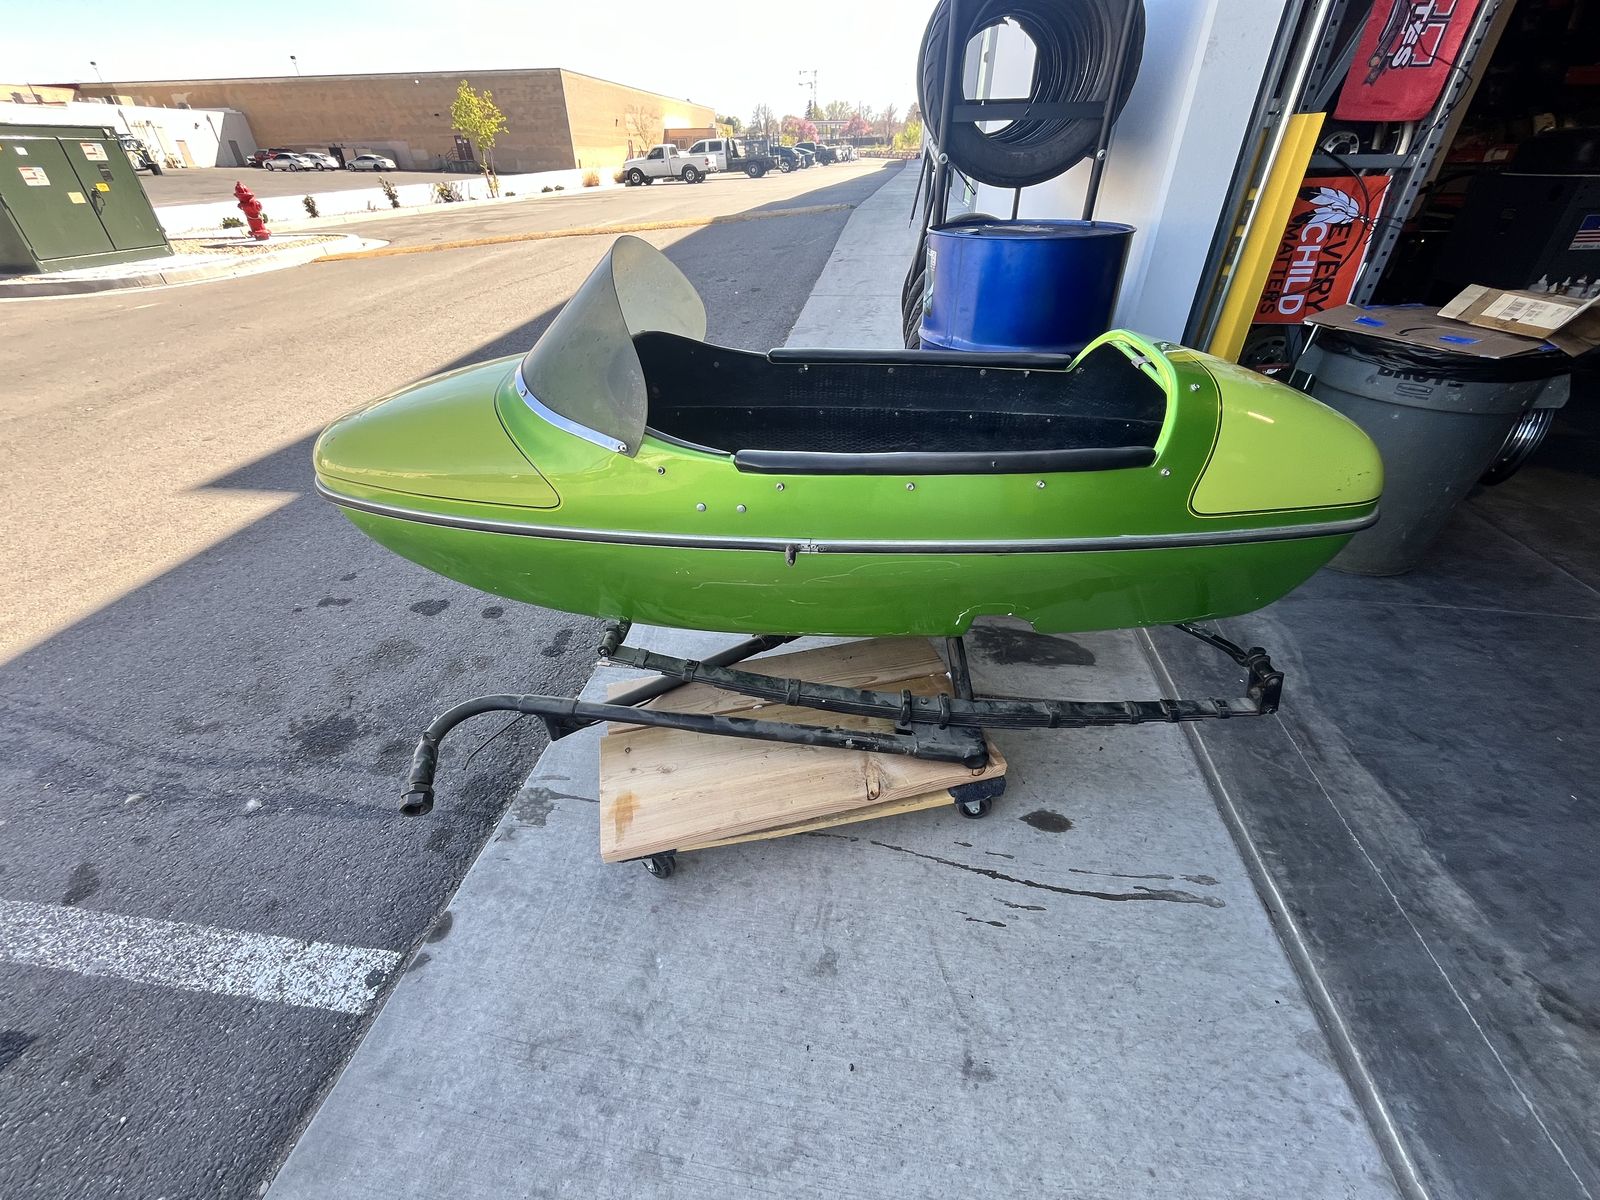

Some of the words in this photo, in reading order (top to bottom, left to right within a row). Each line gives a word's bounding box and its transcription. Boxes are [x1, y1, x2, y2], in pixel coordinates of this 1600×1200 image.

[1260, 222, 1303, 314] MATTERS
[1278, 222, 1328, 315] CHILD
[1305, 223, 1352, 312] EVERY
